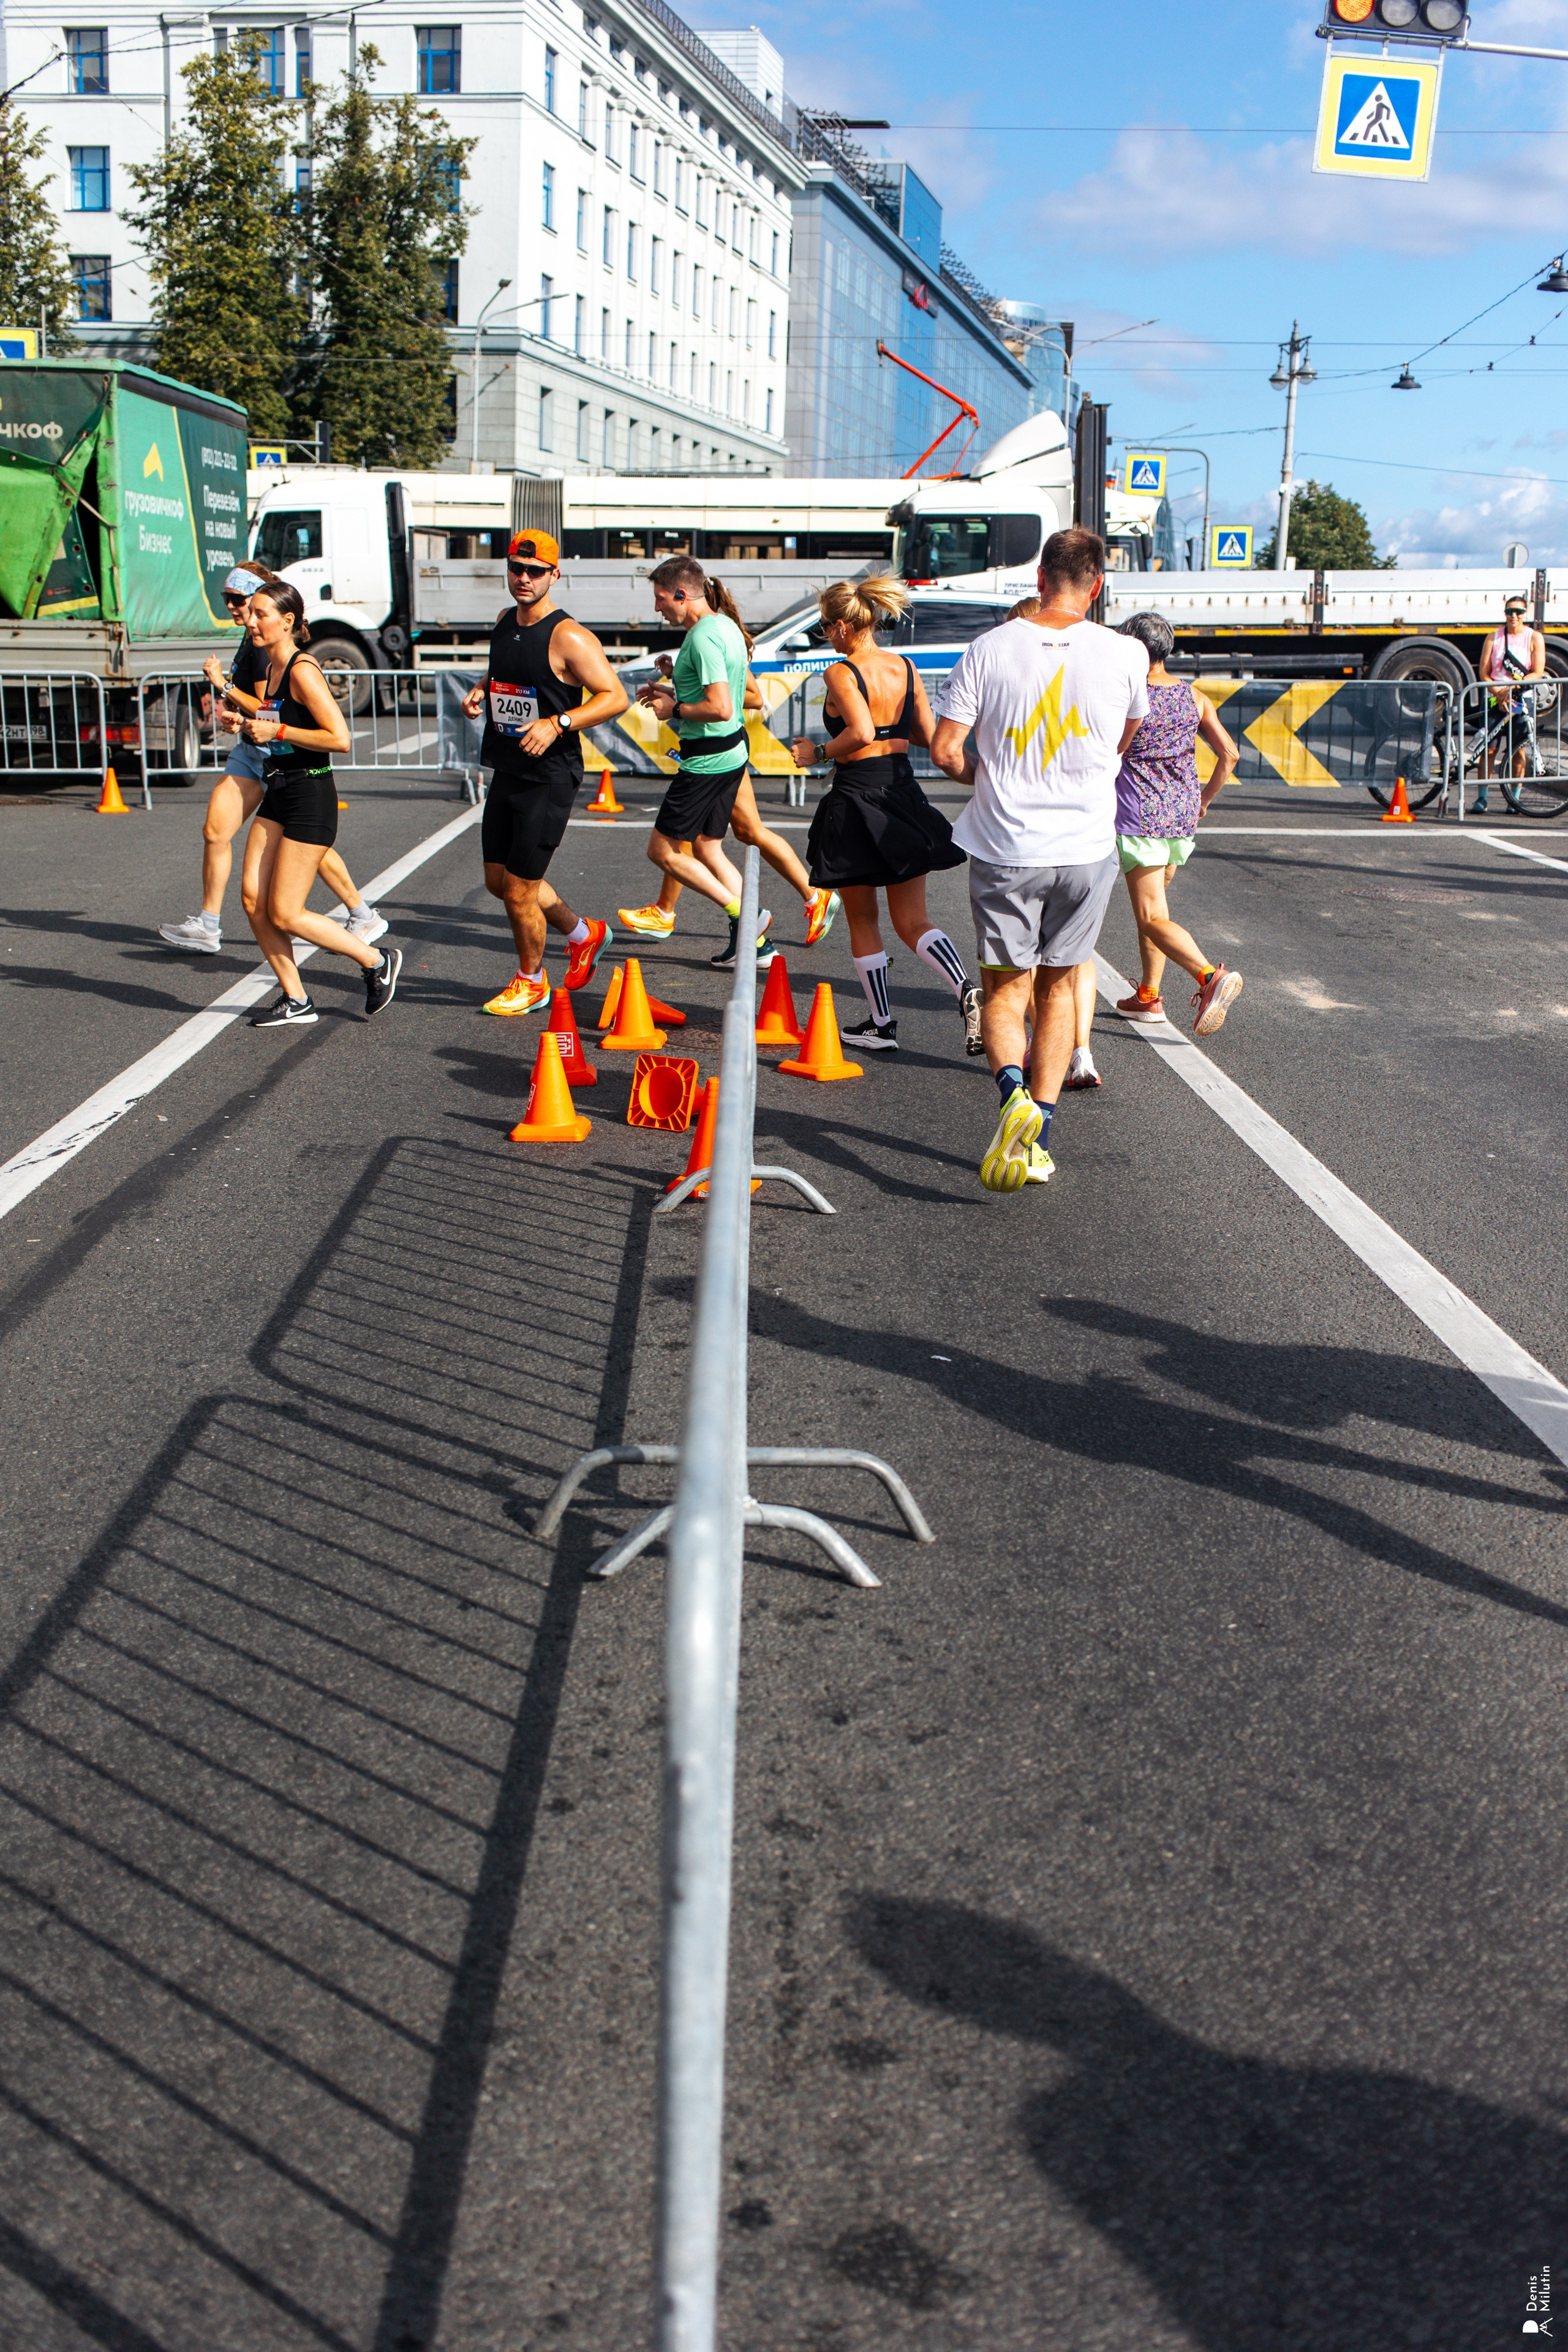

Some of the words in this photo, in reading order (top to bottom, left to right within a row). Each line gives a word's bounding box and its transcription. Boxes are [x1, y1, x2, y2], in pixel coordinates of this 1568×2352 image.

[124, 490, 184, 521] грузовичкоф
[203, 484, 241, 514] Перевезём
[139, 524, 172, 554] Бизнес
[205, 520, 214, 537] на
[214, 518, 237, 540] новый
[205, 549, 235, 572] уровень
[784, 660, 843, 673] ПОЛИЦ
[497, 698, 532, 717] 2409
[498, 723, 503, 733] D
